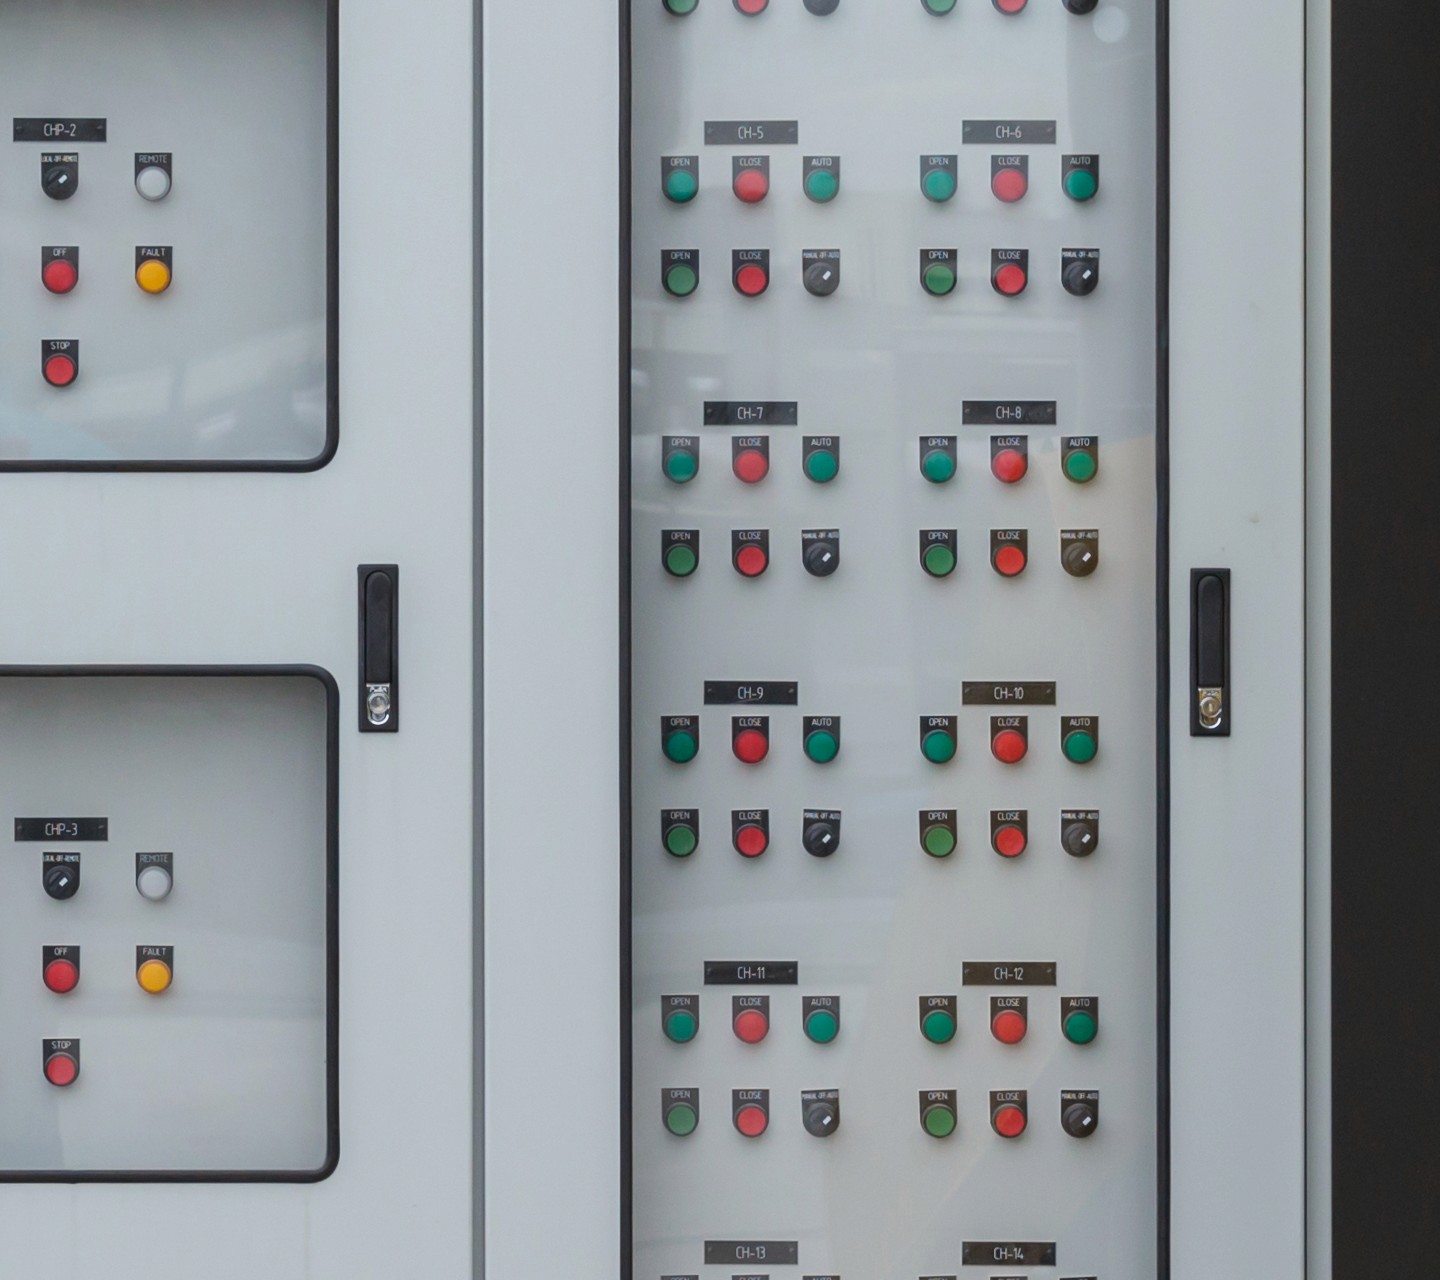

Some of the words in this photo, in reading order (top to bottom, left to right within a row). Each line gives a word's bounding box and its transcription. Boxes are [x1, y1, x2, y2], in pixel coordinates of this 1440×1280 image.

[44, 124, 76, 137] CHP-2
[737, 126, 764, 139] CH-5
[996, 126, 1023, 138] CH-6
[139, 155, 167, 163] REMOTE
[671, 158, 690, 166] OPEN
[740, 158, 762, 166] CLOSE
[811, 158, 832, 166] AUTO
[929, 157, 949, 165] OPEN
[998, 157, 1020, 165] CLOSE
[1069, 157, 1091, 166] AUTO
[53, 248, 67, 257] OFF
[141, 248, 165, 257] FAULT
[671, 252, 690, 260] OPEN
[739, 251, 762, 260] CLOSE
[929, 251, 949, 259] OPEN
[998, 251, 1020, 259] CLOSE
[50, 341, 70, 350] STOP
[737, 407, 764, 419] CH-7
[996, 406, 1022, 419] CH-8
[671, 438, 691, 446] OPEN
[739, 438, 762, 446] CLOSE
[811, 438, 832, 446] AUTO
[928, 438, 949, 446] OPEN
[998, 438, 1020, 446] CLOSE
[1070, 438, 1090, 447] AUTO
[671, 532, 690, 540] OPEN
[739, 532, 762, 540] CLOSE
[928, 532, 949, 540] OPEN
[998, 531, 1020, 540] CLOSE
[737, 687, 764, 700] CH-9
[993, 687, 1024, 699] CH-10
[671, 718, 690, 726] OPEN
[739, 718, 762, 726] CLOSE
[811, 718, 832, 726] AUTO
[929, 718, 949, 726] OPEN
[998, 718, 1020, 726] CLOSE
[1070, 718, 1091, 726] AUTO
[671, 811, 690, 820] OPEN
[739, 812, 762, 820] CLOSE
[928, 812, 948, 820] OPEN
[998, 812, 1020, 820] CLOSE
[45, 823, 78, 836] CHP-3
[139, 854, 168, 863] REMOTE
[54, 947, 68, 956] OFF
[143, 948, 166, 956] FAULT
[737, 967, 766, 979] CH-11
[993, 967, 1024, 980] CH-12
[671, 998, 690, 1006] OPEN
[740, 998, 762, 1006] CLOSE
[811, 998, 832, 1006] AUTO
[928, 998, 949, 1006] OPEN
[998, 998, 1020, 1006] CLOSE
[1070, 999, 1090, 1007] AUTO
[51, 1041, 71, 1050] STOP
[671, 1090, 690, 1099] OPEN
[739, 1091, 762, 1099] CLOSE
[928, 1092, 948, 1100] OPEN
[997, 1092, 1020, 1101] CLOSE
[736, 1246, 766, 1259] CH-13
[993, 1247, 1024, 1260] CH-14
